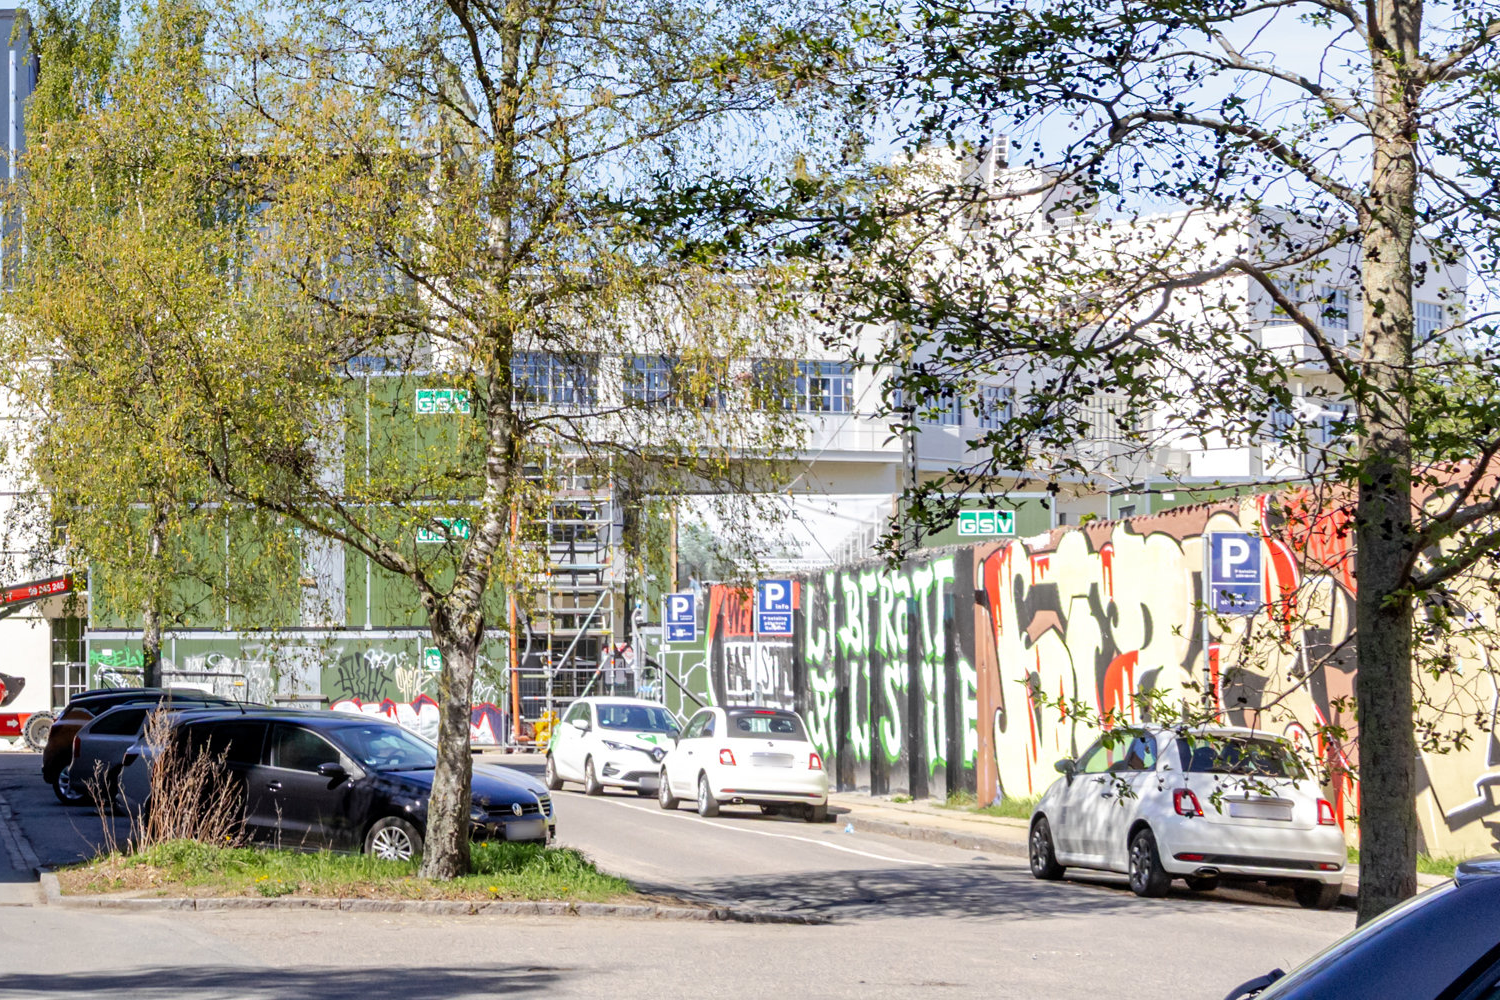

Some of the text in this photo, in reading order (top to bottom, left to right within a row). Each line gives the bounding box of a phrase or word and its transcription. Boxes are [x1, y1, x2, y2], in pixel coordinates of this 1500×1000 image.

[961, 519, 1012, 533] GSV
[1222, 538, 1250, 578] P
[672, 597, 689, 621] P
[765, 583, 785, 610] P
